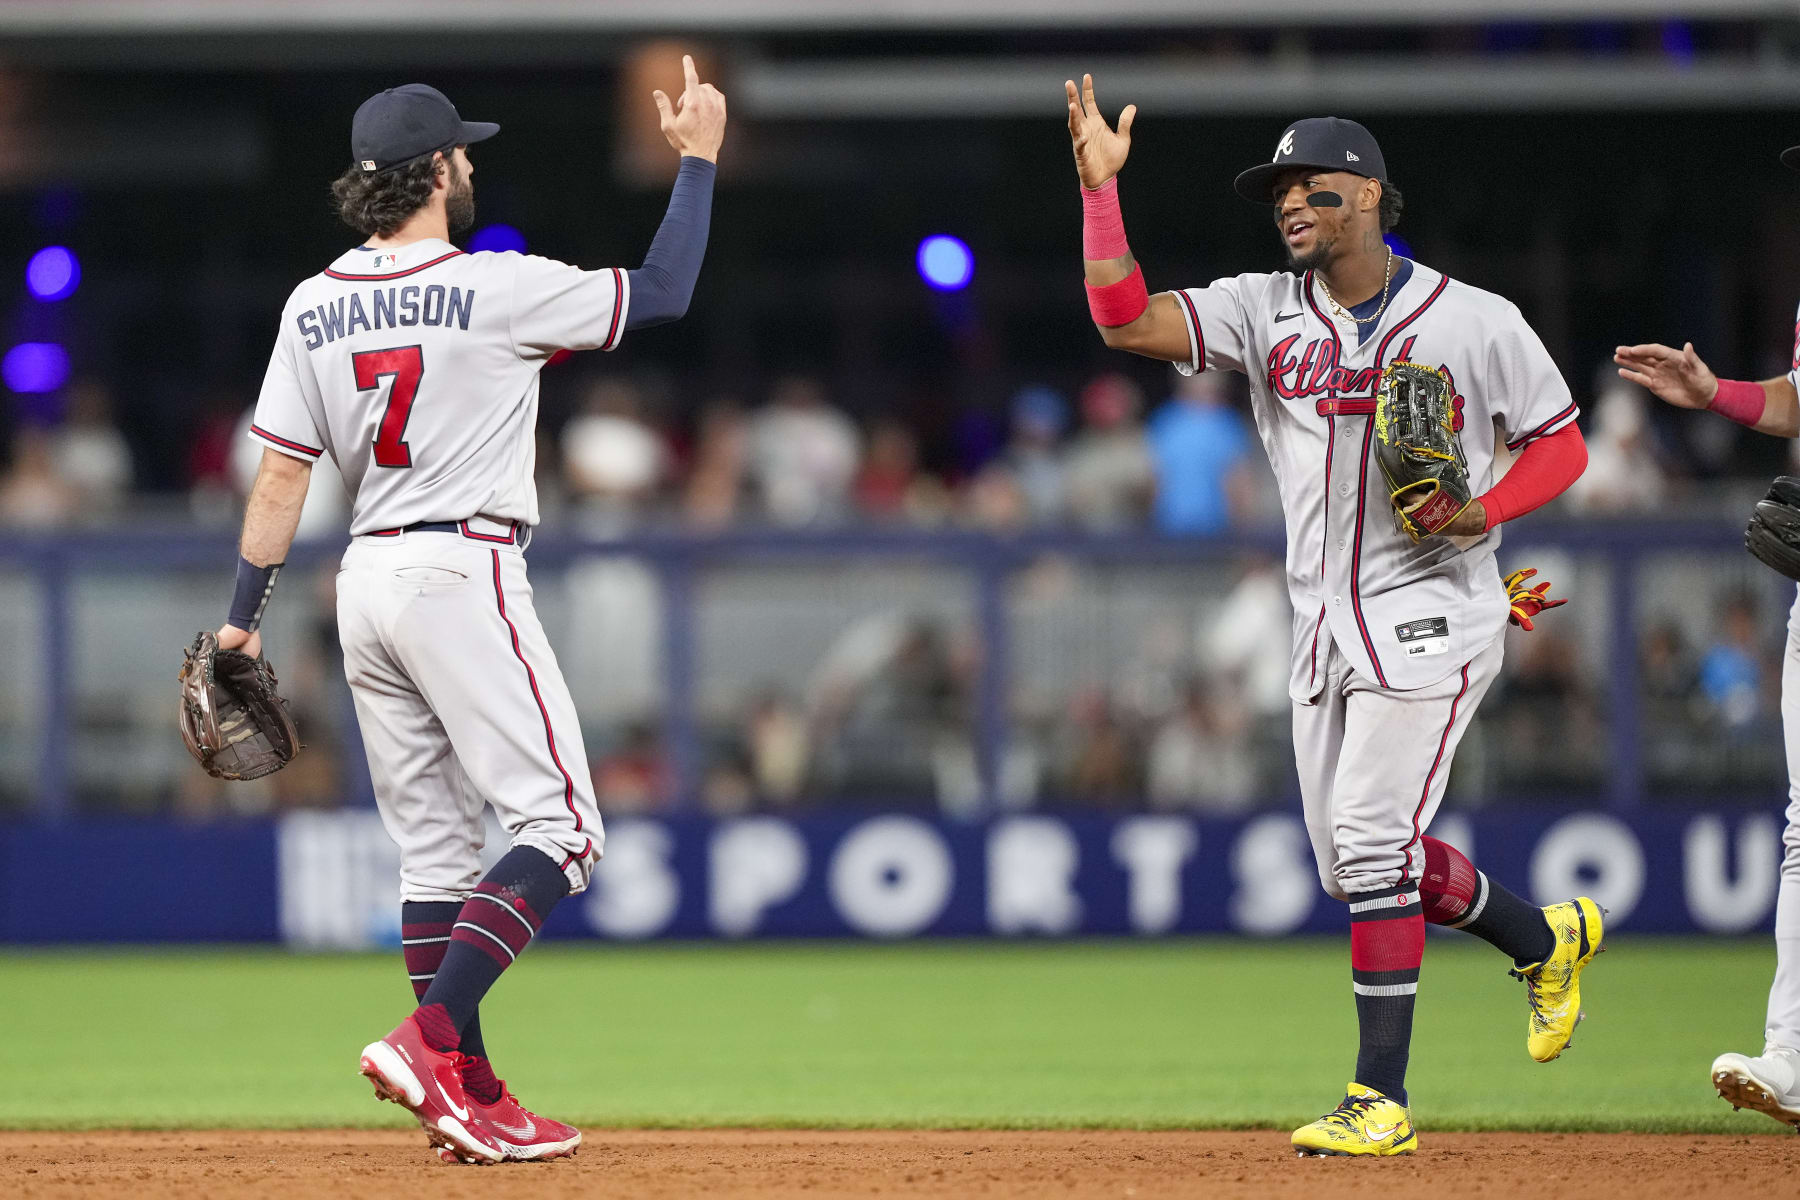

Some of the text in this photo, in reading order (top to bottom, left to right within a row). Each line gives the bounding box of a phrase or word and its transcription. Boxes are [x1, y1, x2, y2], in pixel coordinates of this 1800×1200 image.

[296, 284, 475, 351] SWANSON
[352, 344, 424, 468] 7
[586, 815, 1315, 936] SPORTS
